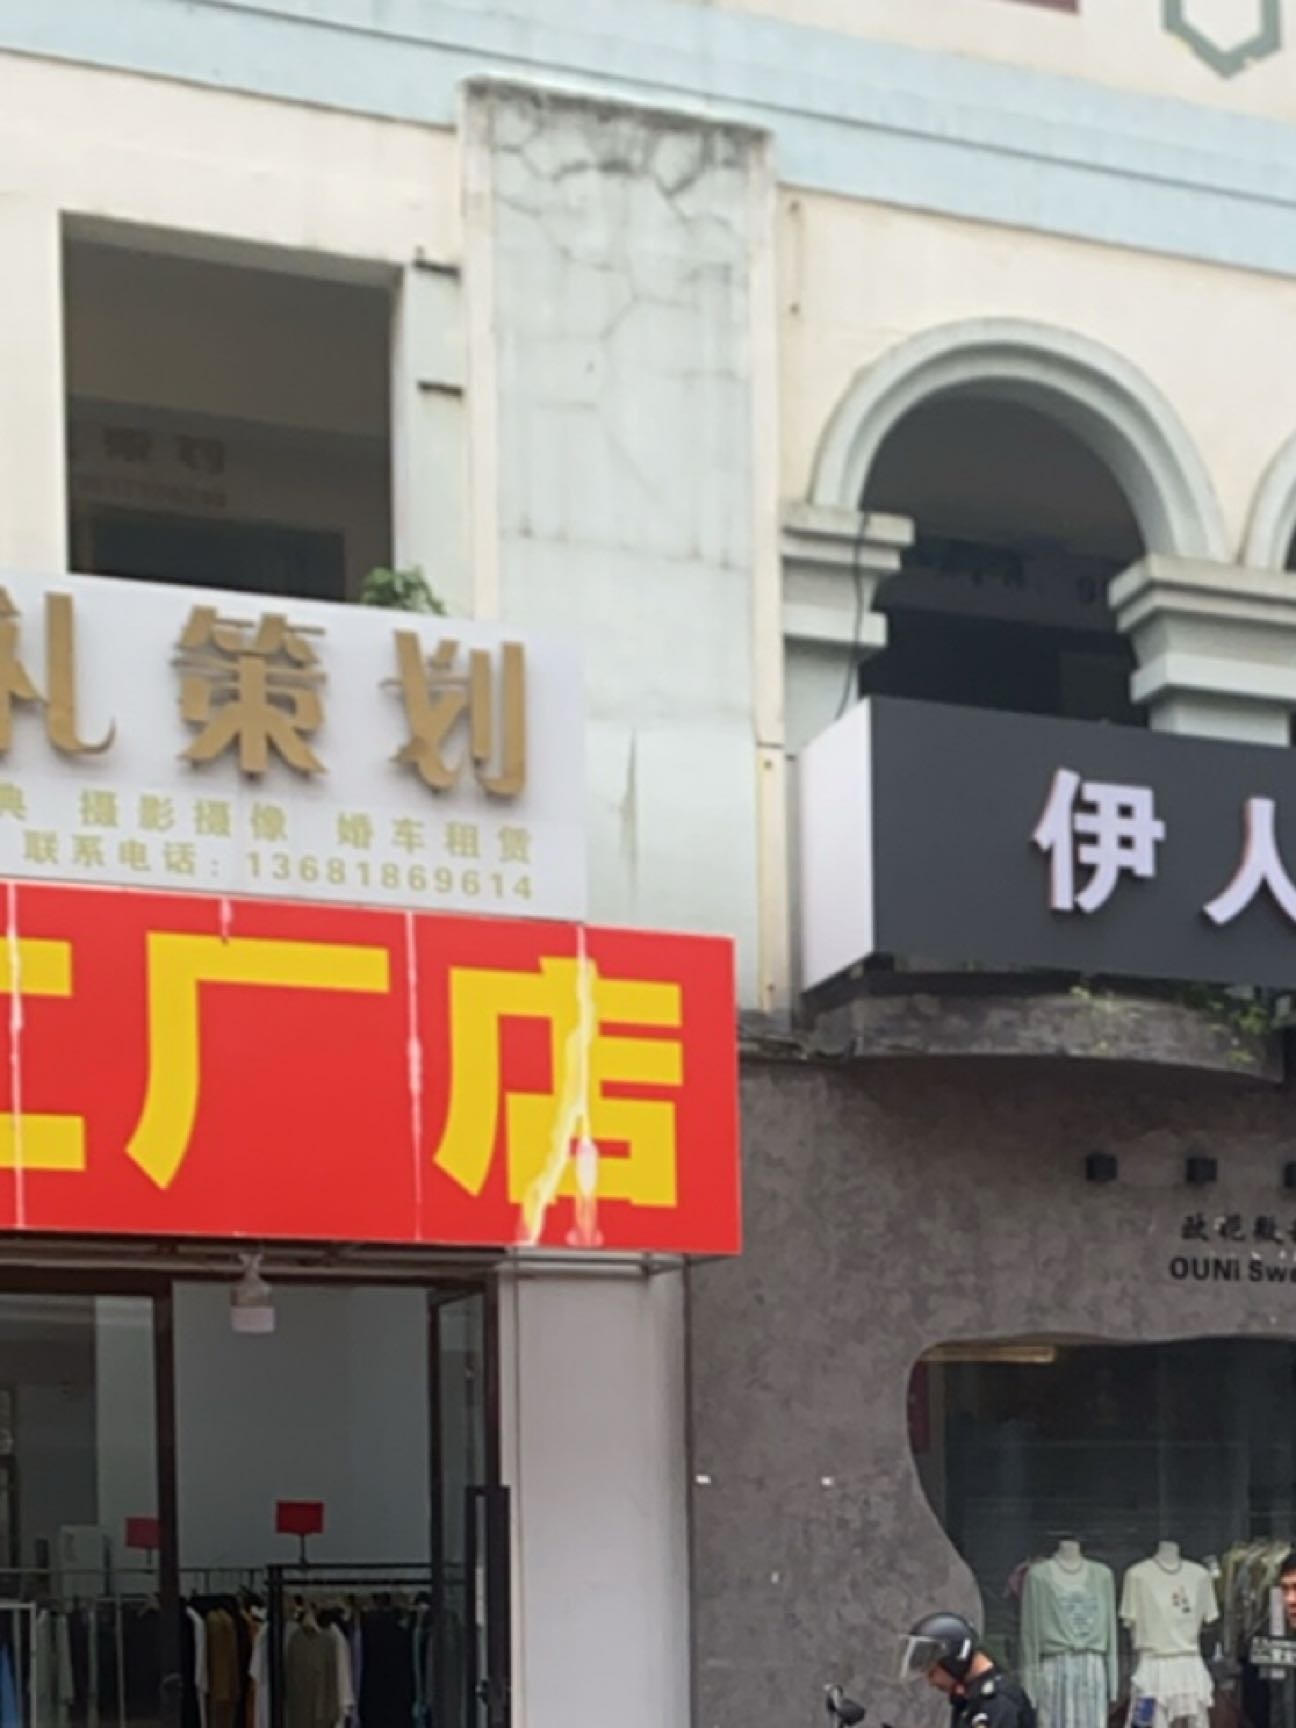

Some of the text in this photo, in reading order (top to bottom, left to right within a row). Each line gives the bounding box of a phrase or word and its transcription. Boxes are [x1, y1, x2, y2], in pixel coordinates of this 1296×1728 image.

[80, 789, 289, 843] 摄影摄像
[336, 811, 533, 865] 婚车租赁
